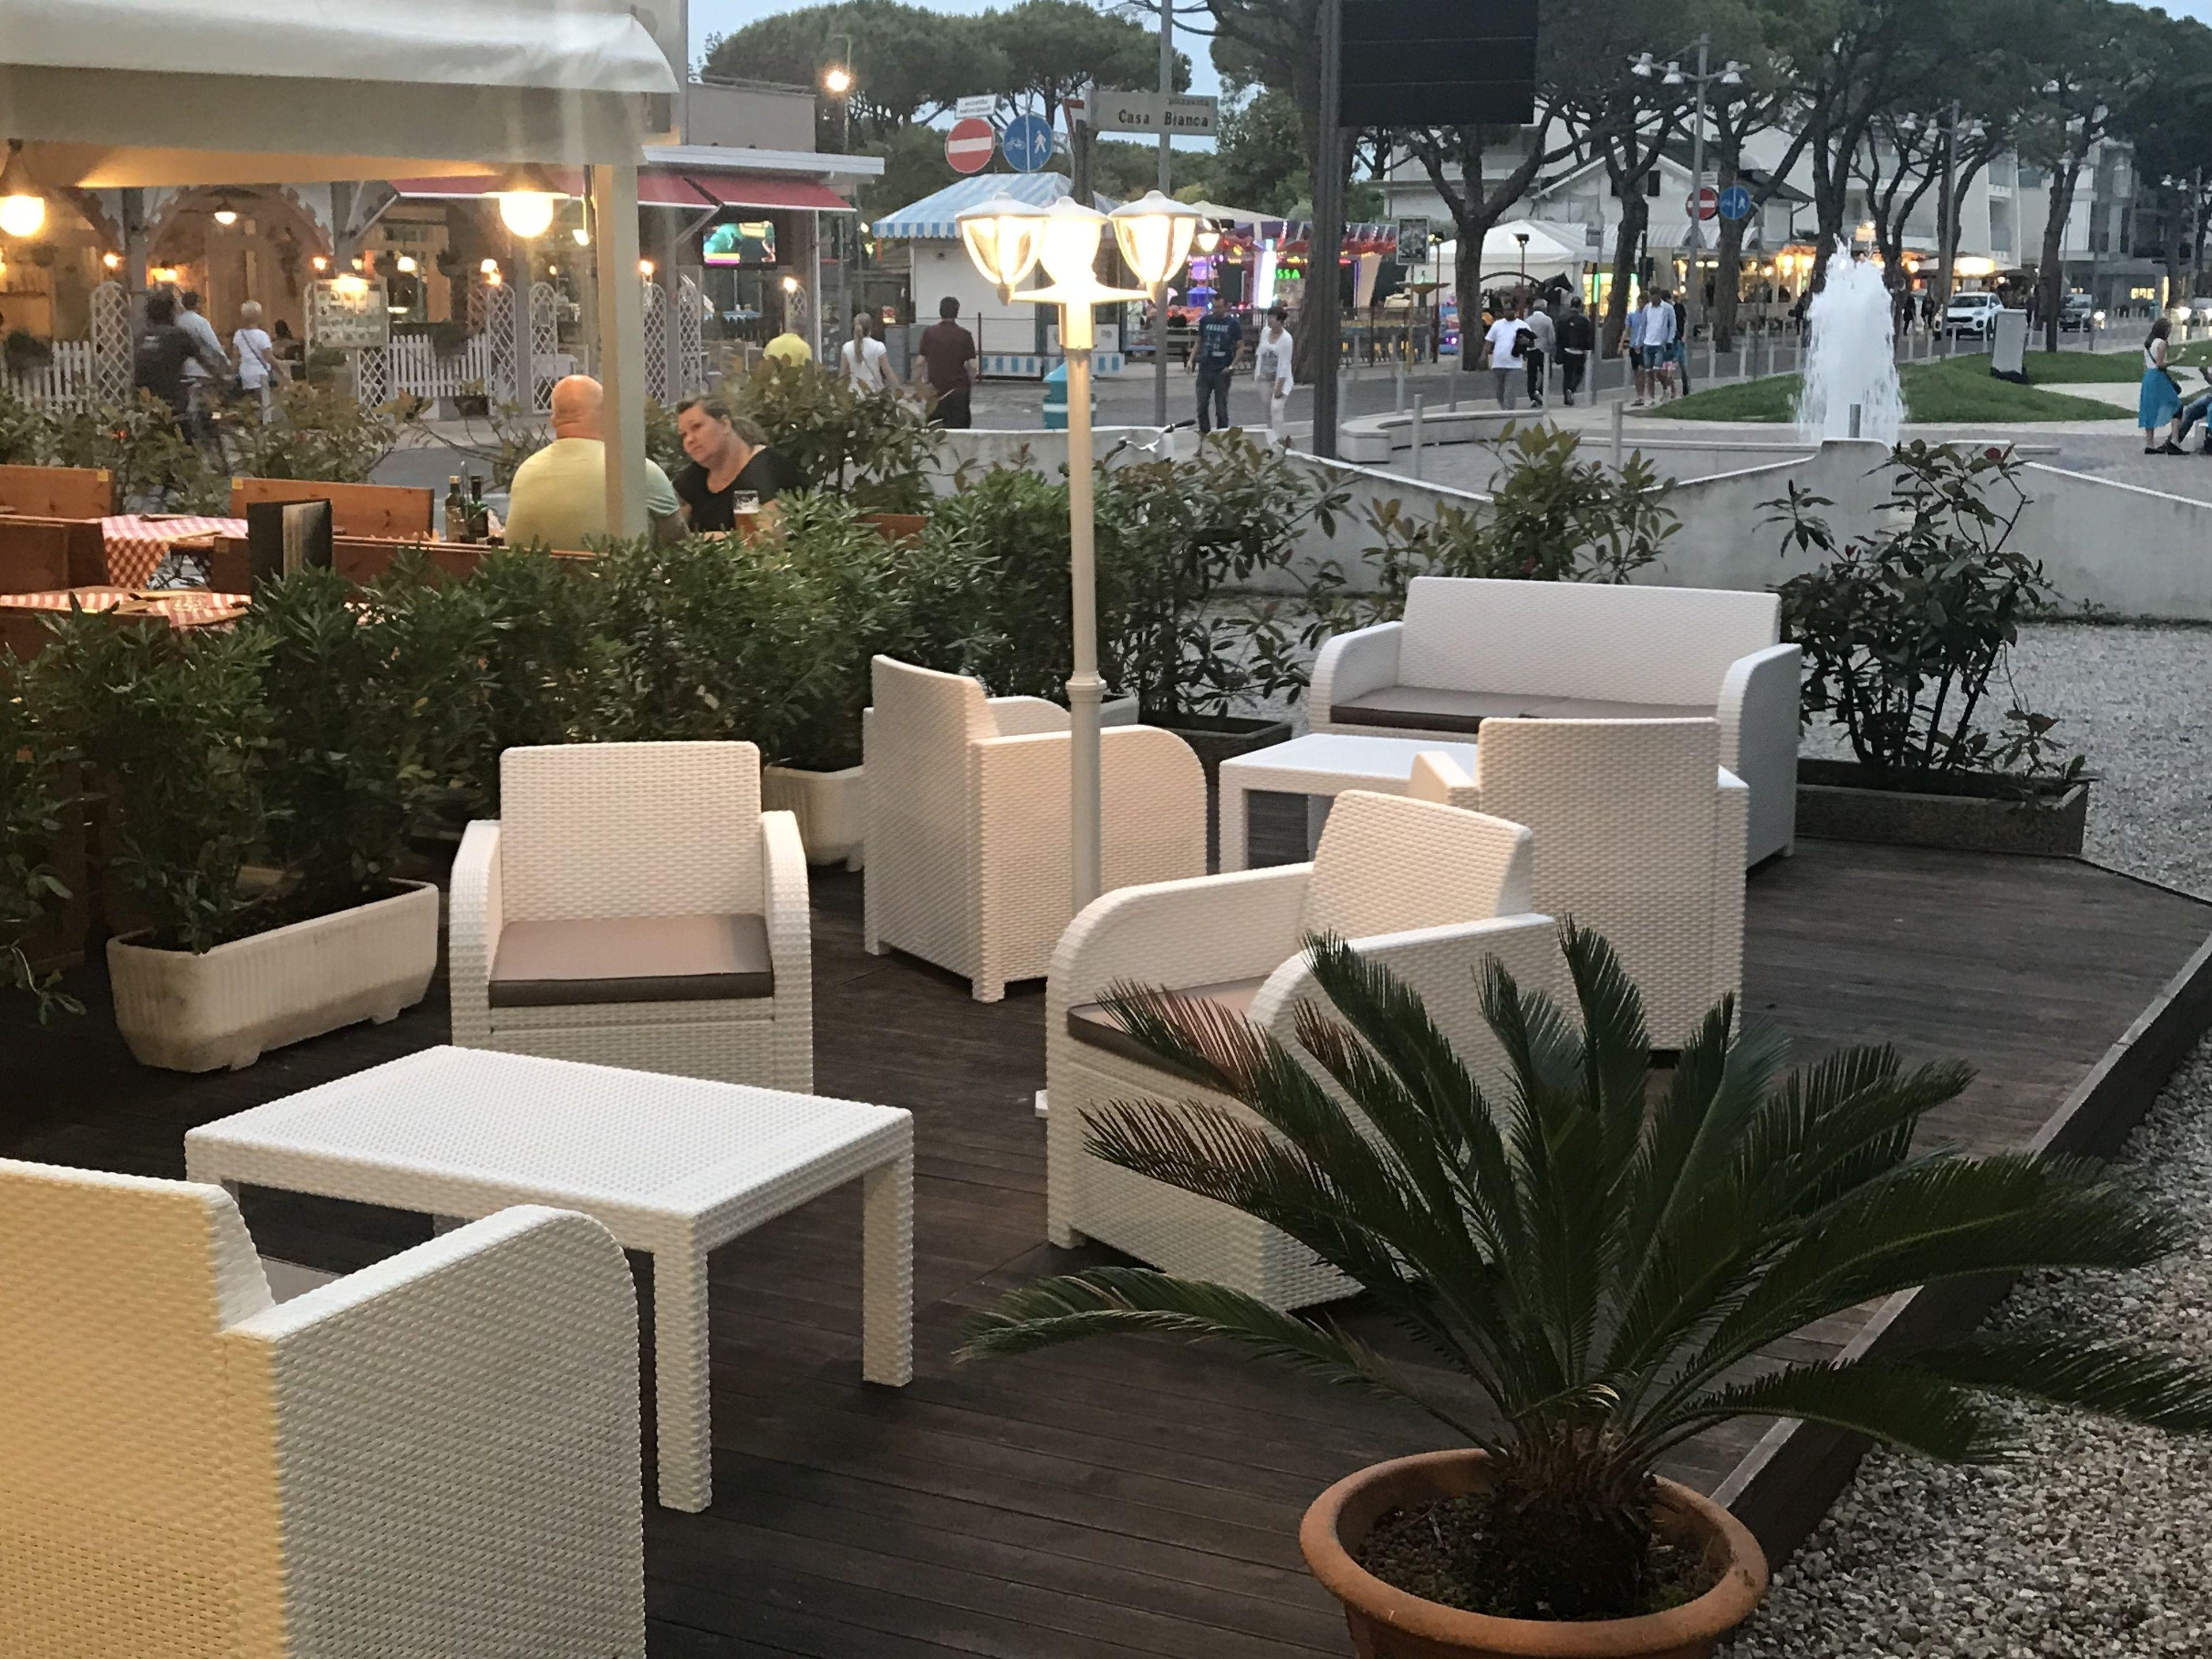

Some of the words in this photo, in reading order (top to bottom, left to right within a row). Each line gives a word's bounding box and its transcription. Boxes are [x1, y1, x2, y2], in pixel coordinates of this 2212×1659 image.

[1118, 109, 1150, 124] Casa
[1164, 111, 1209, 127] Bianca
[1276, 268, 1300, 279] SSA
